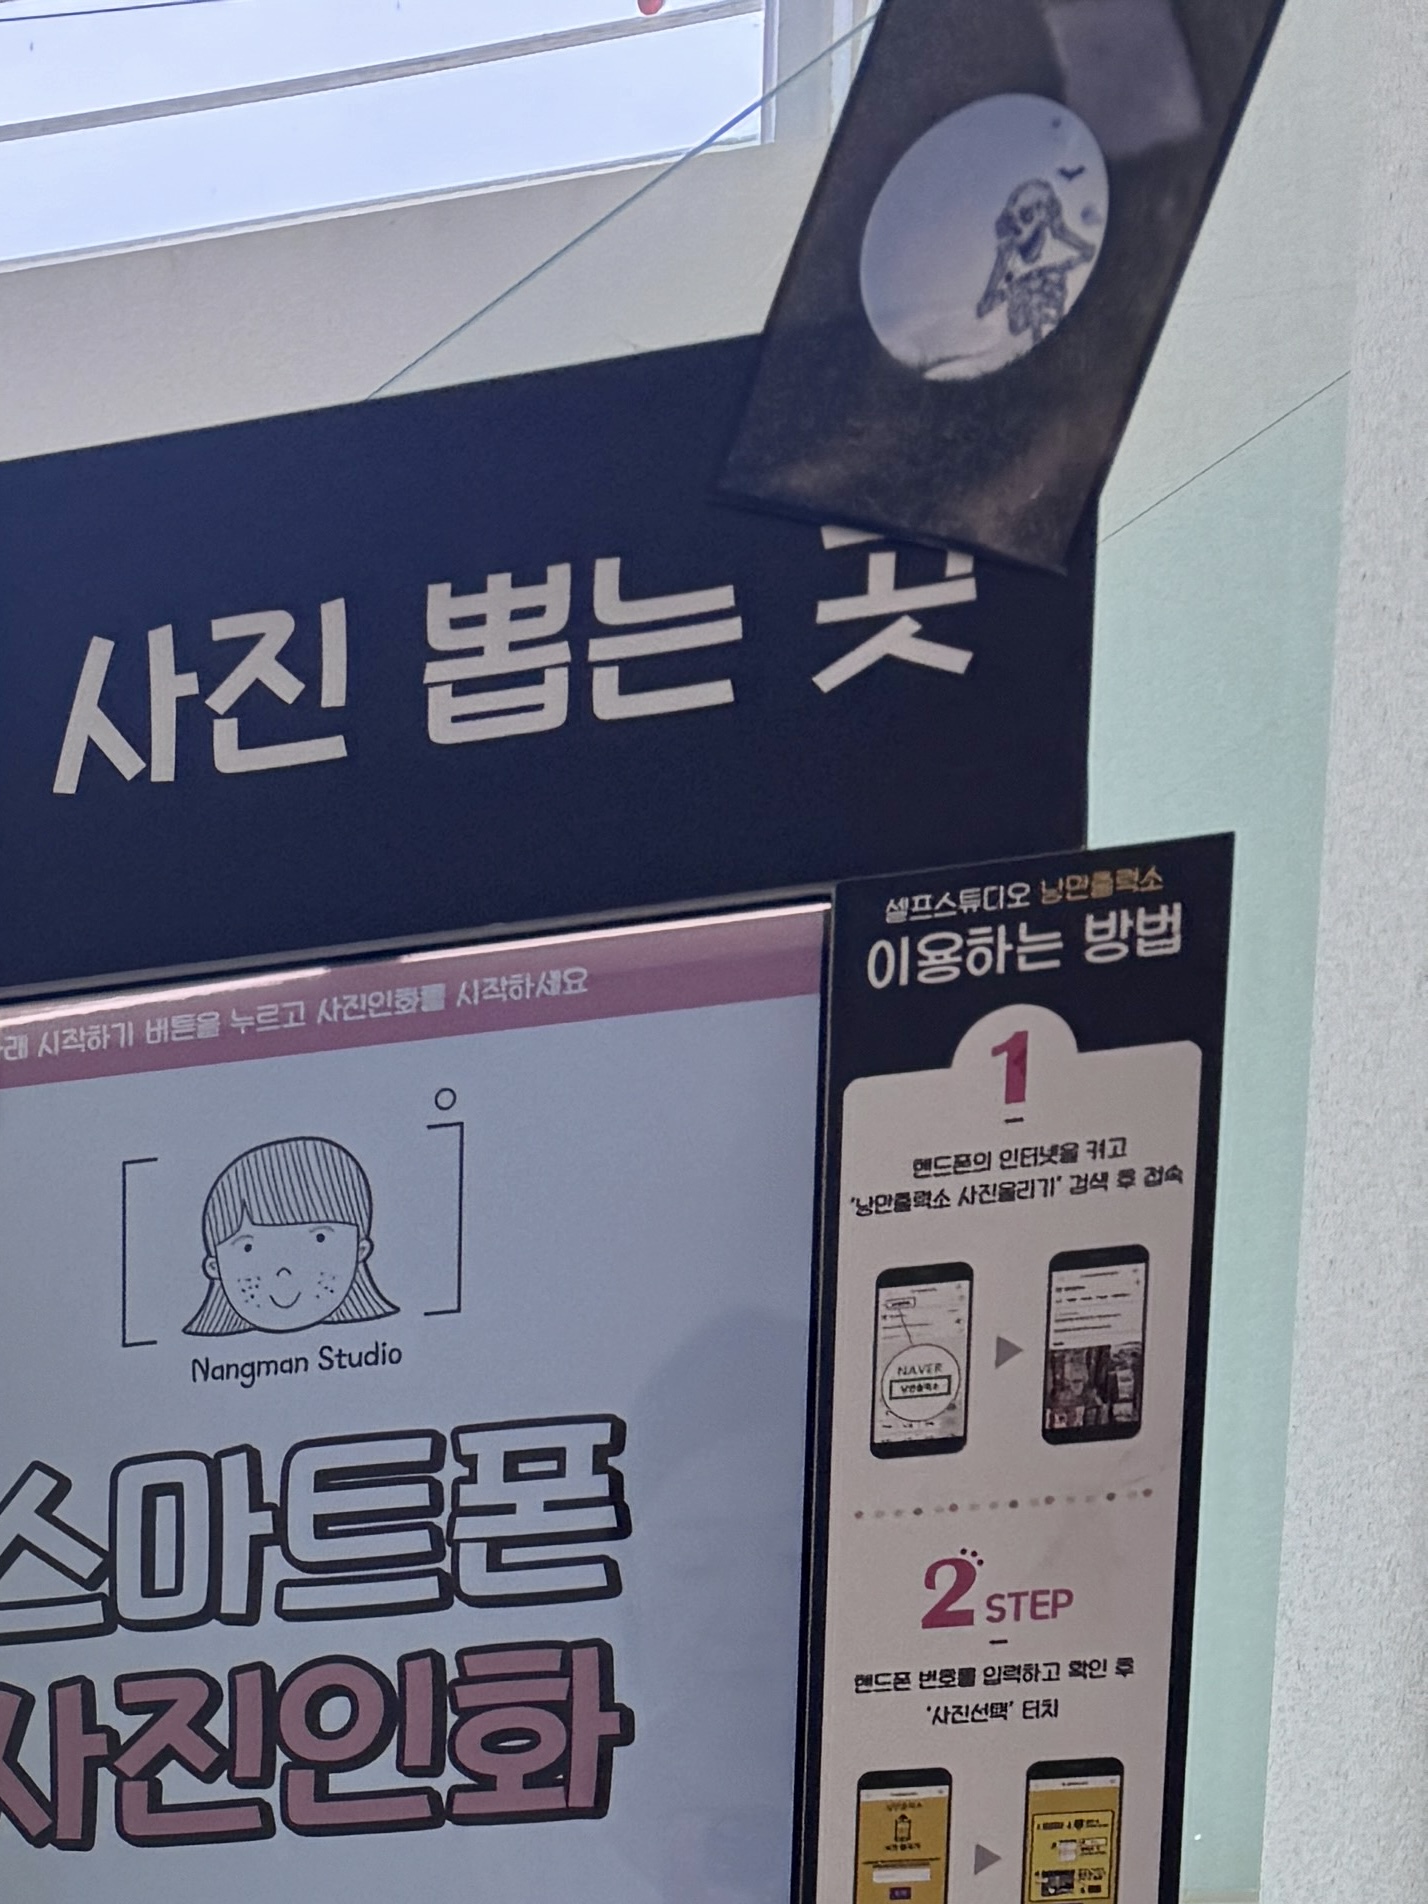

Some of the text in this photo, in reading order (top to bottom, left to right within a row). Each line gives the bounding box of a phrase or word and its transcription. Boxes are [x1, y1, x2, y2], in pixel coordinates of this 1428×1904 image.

[53, 598, 347, 794] 사진
[423, 556, 743, 745] 뽑는
[885, 866, 1164, 924] 셀프스튜디오 낭만출력소
[867, 902, 1183, 989] 이용하는 방법
[37, 1020, 135, 1058] 시작하기
[146, 1012, 220, 1046] 버튼을
[230, 1003, 306, 1034] 누르고
[316, 983, 445, 1026] 사진인화를
[456, 967, 588, 1008] 시작하세요
[990, 1029, 1029, 1105] 1
[913, 1151, 992, 1179] 핸드폰의
[999, 1142, 1079, 1170] 인터넷을
[1069, 1171, 1109, 1195] 검색
[1116, 1168, 1136, 1189] 후
[1144, 1164, 1184, 1187] 접속
[191, 1341, 403, 1388] Nangman Studio
[921, 1557, 1075, 1630] 2 STEP
[854, 1657, 1135, 1694] 핸드폰 번호를 입력하고 확인 후
[1022, 1698, 1059, 1720] 터치
